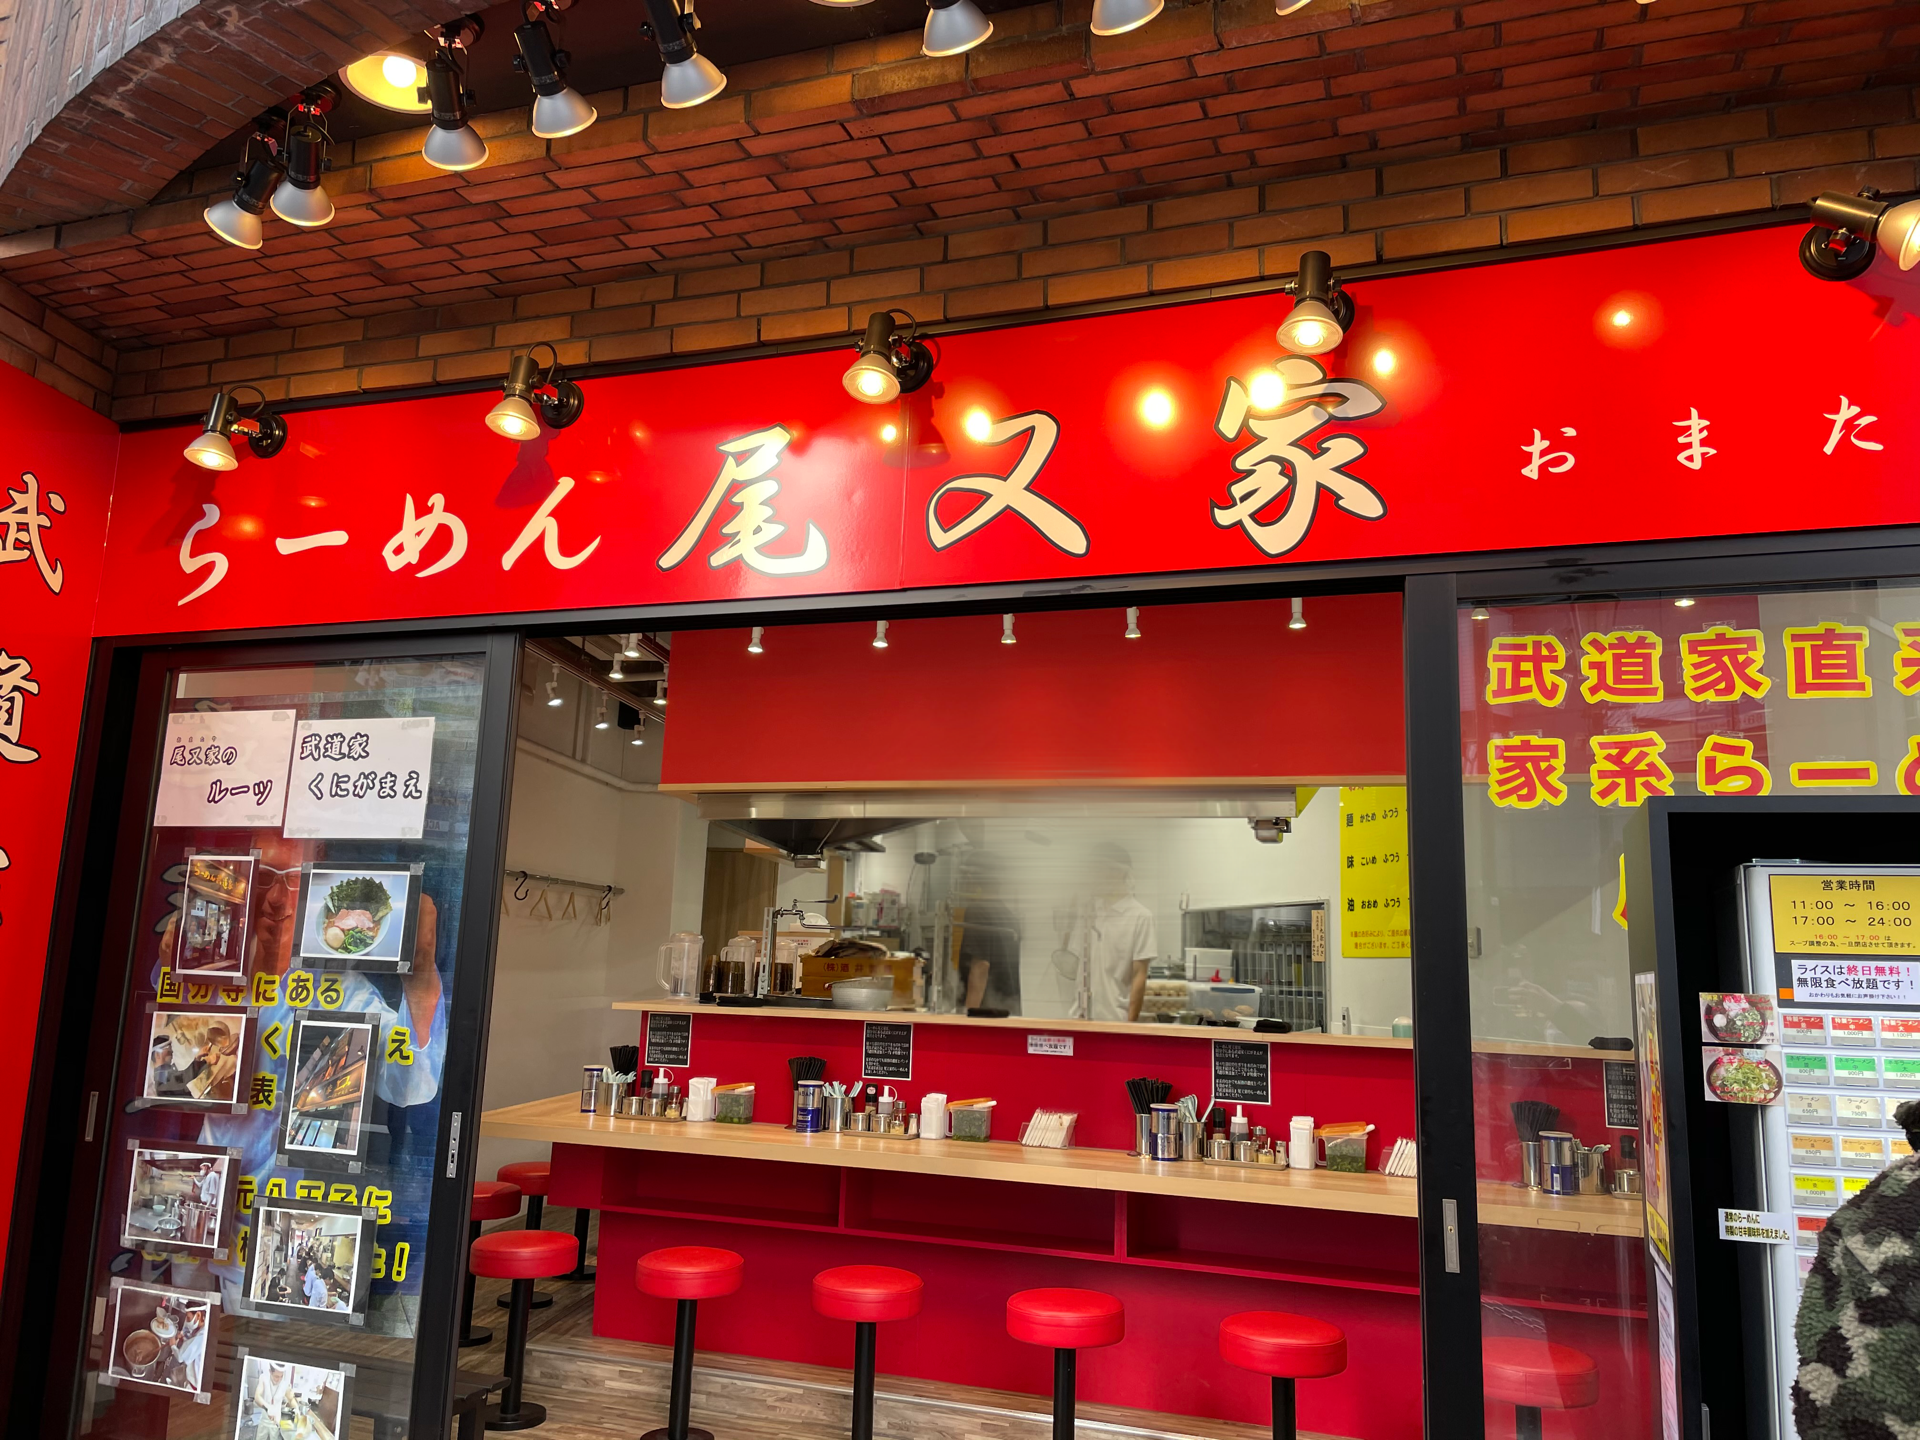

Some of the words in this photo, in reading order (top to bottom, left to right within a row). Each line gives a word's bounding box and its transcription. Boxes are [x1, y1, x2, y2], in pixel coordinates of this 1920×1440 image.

[177, 476, 601, 607] らーめん
[656, 354, 1388, 575] 尾又家
[1486, 624, 1920, 708] 武道家直
[169, 745, 238, 767] 尾又家の
[300, 733, 370, 761] 武道家
[1487, 730, 1920, 807] 家系らー
[206, 779, 273, 806] ルーツ
[308, 770, 422, 800] くにがまえ
[1382, 808, 1399, 820] ふつう
[1347, 855, 1354, 869] 味
[1361, 855, 1377, 866] こいめ
[1383, 852, 1400, 863] ふつう
[1821, 880, 1875, 891] 営業時間
[1347, 898, 1355, 912] 油
[1384, 897, 1401, 908] ふつう
[1791, 900, 1834, 910] 11:00
[1867, 901, 1911, 911] 16:00
[1792, 916, 1835, 925] 17:00
[1868, 917, 1912, 926] 24:00
